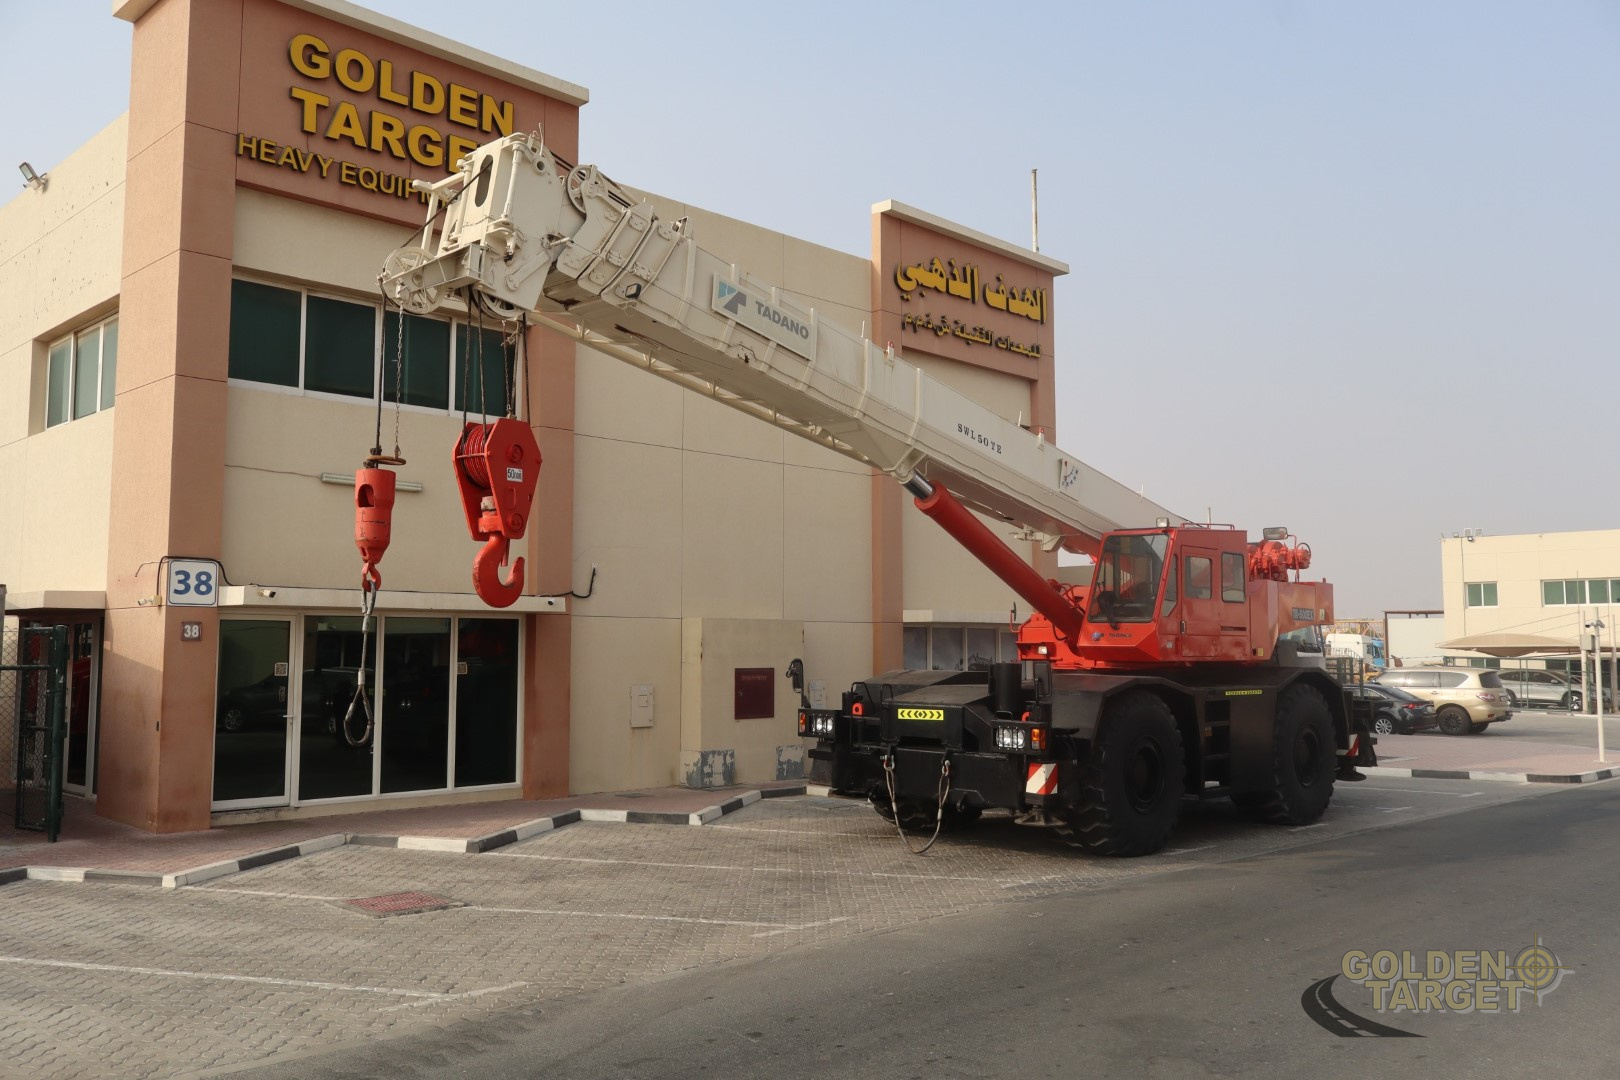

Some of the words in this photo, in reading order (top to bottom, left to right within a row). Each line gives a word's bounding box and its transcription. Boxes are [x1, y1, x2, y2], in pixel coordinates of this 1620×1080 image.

[289, 34, 514, 137] GOLDEN
[290, 86, 482, 175] TARGE
[237, 133, 335, 178] HEAVY
[340, 160, 448, 208] EQUIP
[895, 256, 979, 304] الذهبي
[984, 273, 1048, 324] الهدف
[755, 300, 809, 340] TADANO
[995, 335, 1041, 358] للمعدات
[173, 570, 213, 596] 38
[184, 624, 199, 638] 38
